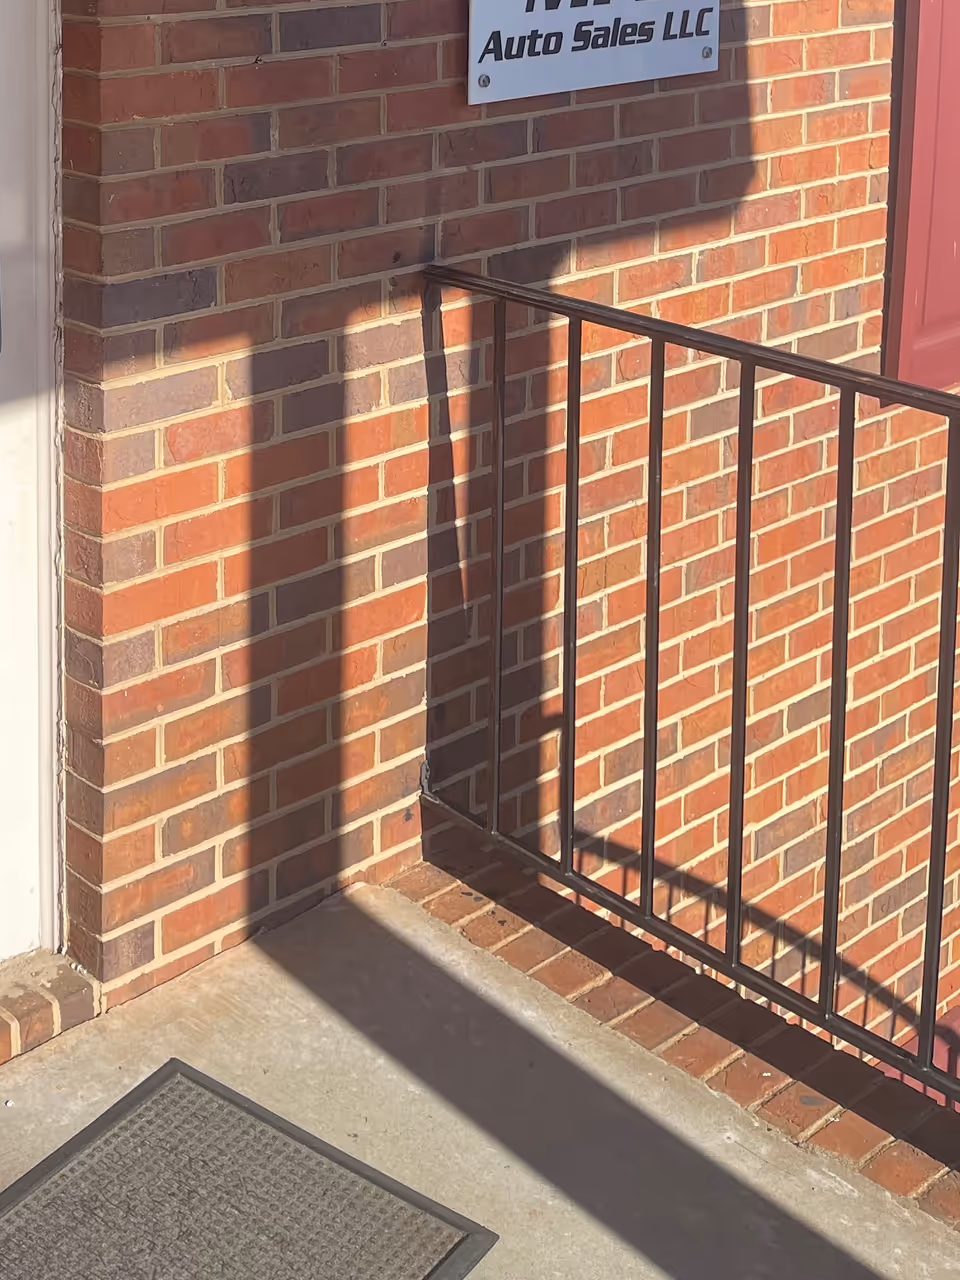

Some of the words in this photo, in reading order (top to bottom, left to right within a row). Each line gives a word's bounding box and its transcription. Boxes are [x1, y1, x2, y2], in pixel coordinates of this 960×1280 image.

[478, 29, 563, 63] Auto
[571, 17, 655, 52] Sales
[662, 7, 713, 41] LLC
